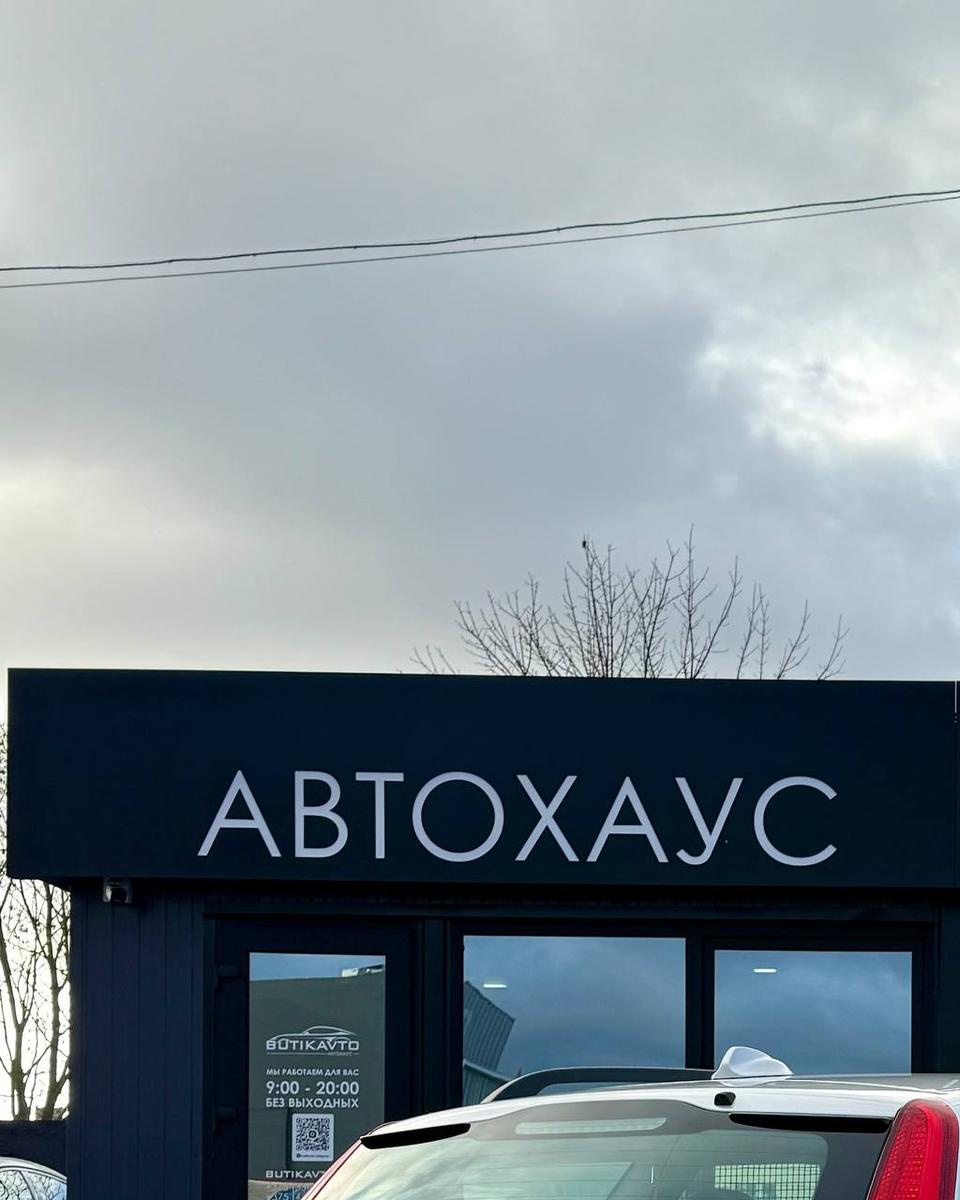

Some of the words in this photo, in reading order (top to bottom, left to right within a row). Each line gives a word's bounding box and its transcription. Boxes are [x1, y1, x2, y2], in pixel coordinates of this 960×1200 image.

[197, 770, 837, 866] АВТОХАУС
[265, 1039, 360, 1051] BUTIKAVTO
[266, 1068, 281, 1076] МЫ
[281, 1068, 324, 1076] РАБОТАЕМ
[324, 1068, 342, 1078] ДЛЯ
[343, 1068, 359, 1077] ВАС
[266, 1080, 300, 1095] 9:00
[316, 1080, 360, 1095] 20:00
[265, 1097, 285, 1108] БЕЗ
[288, 1097, 359, 1110] ВЫХОДНЫХ
